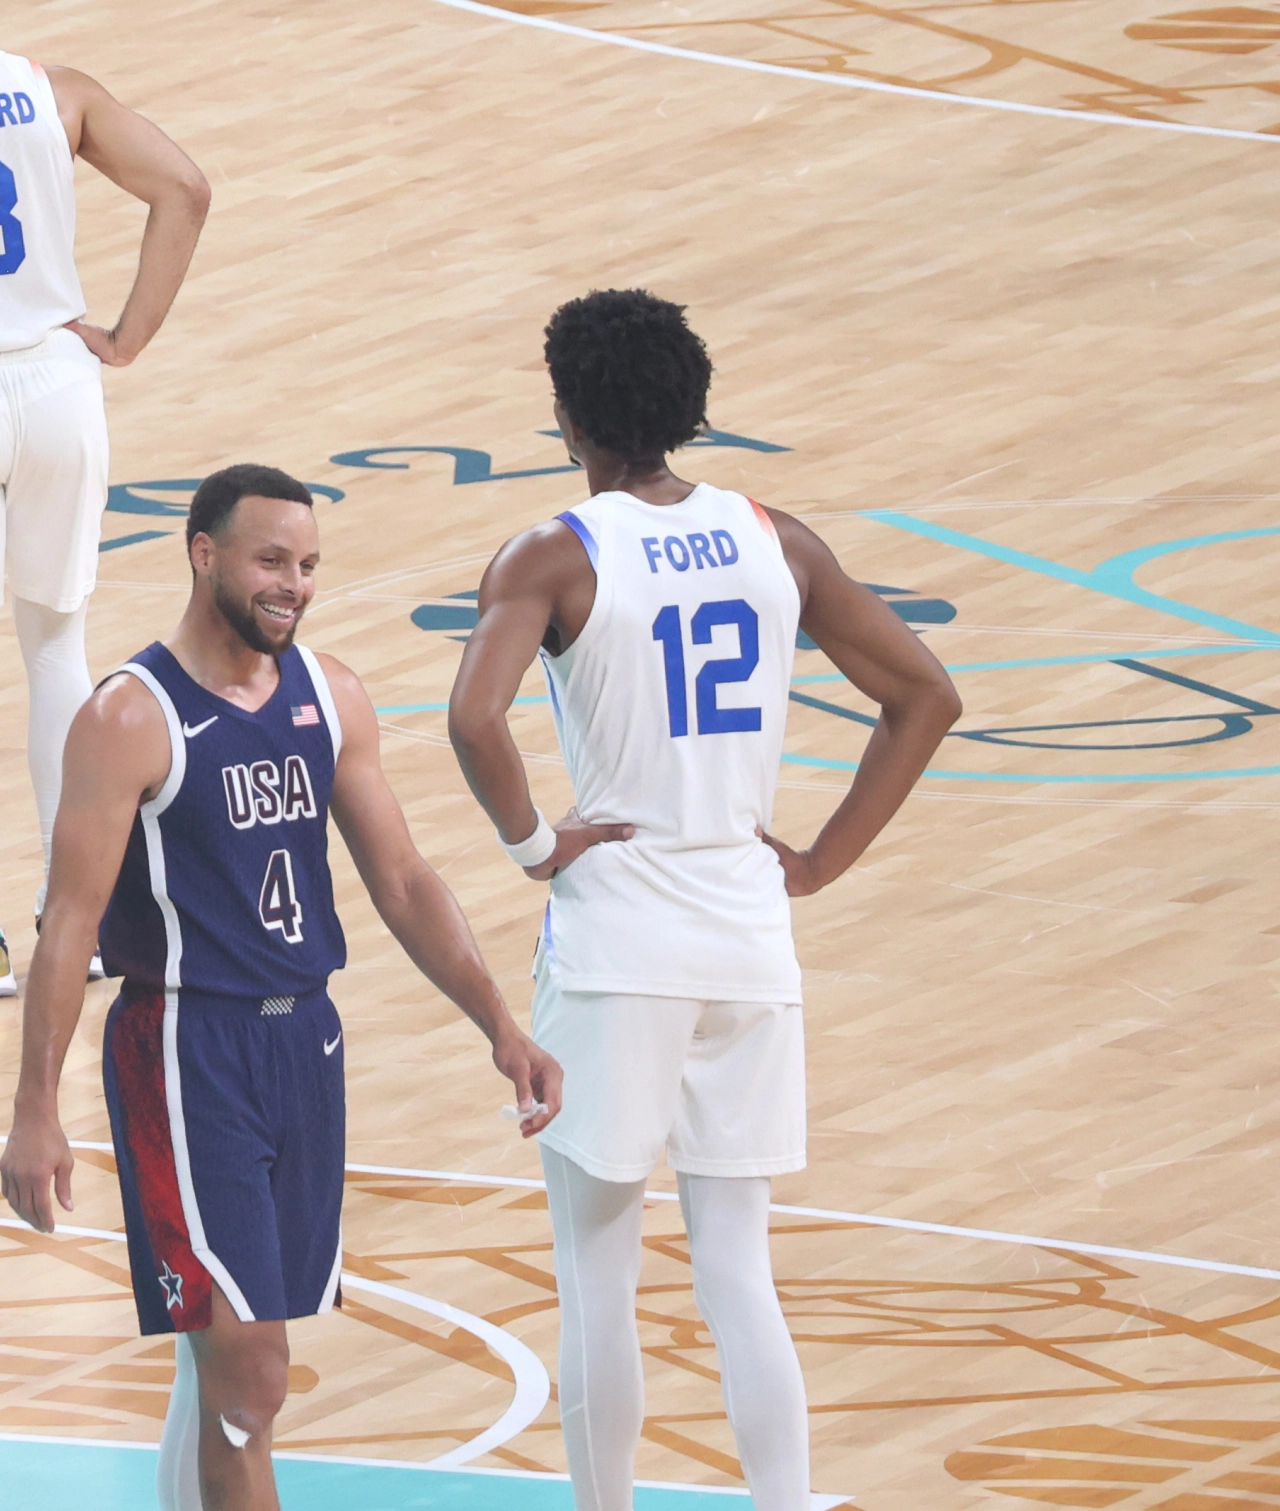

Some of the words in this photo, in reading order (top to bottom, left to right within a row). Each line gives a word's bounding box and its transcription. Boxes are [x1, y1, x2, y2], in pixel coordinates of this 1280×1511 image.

[641, 528, 739, 574] FORD
[651, 598, 762, 739] 12
[222, 755, 318, 830] USA
[258, 849, 304, 944] 4
